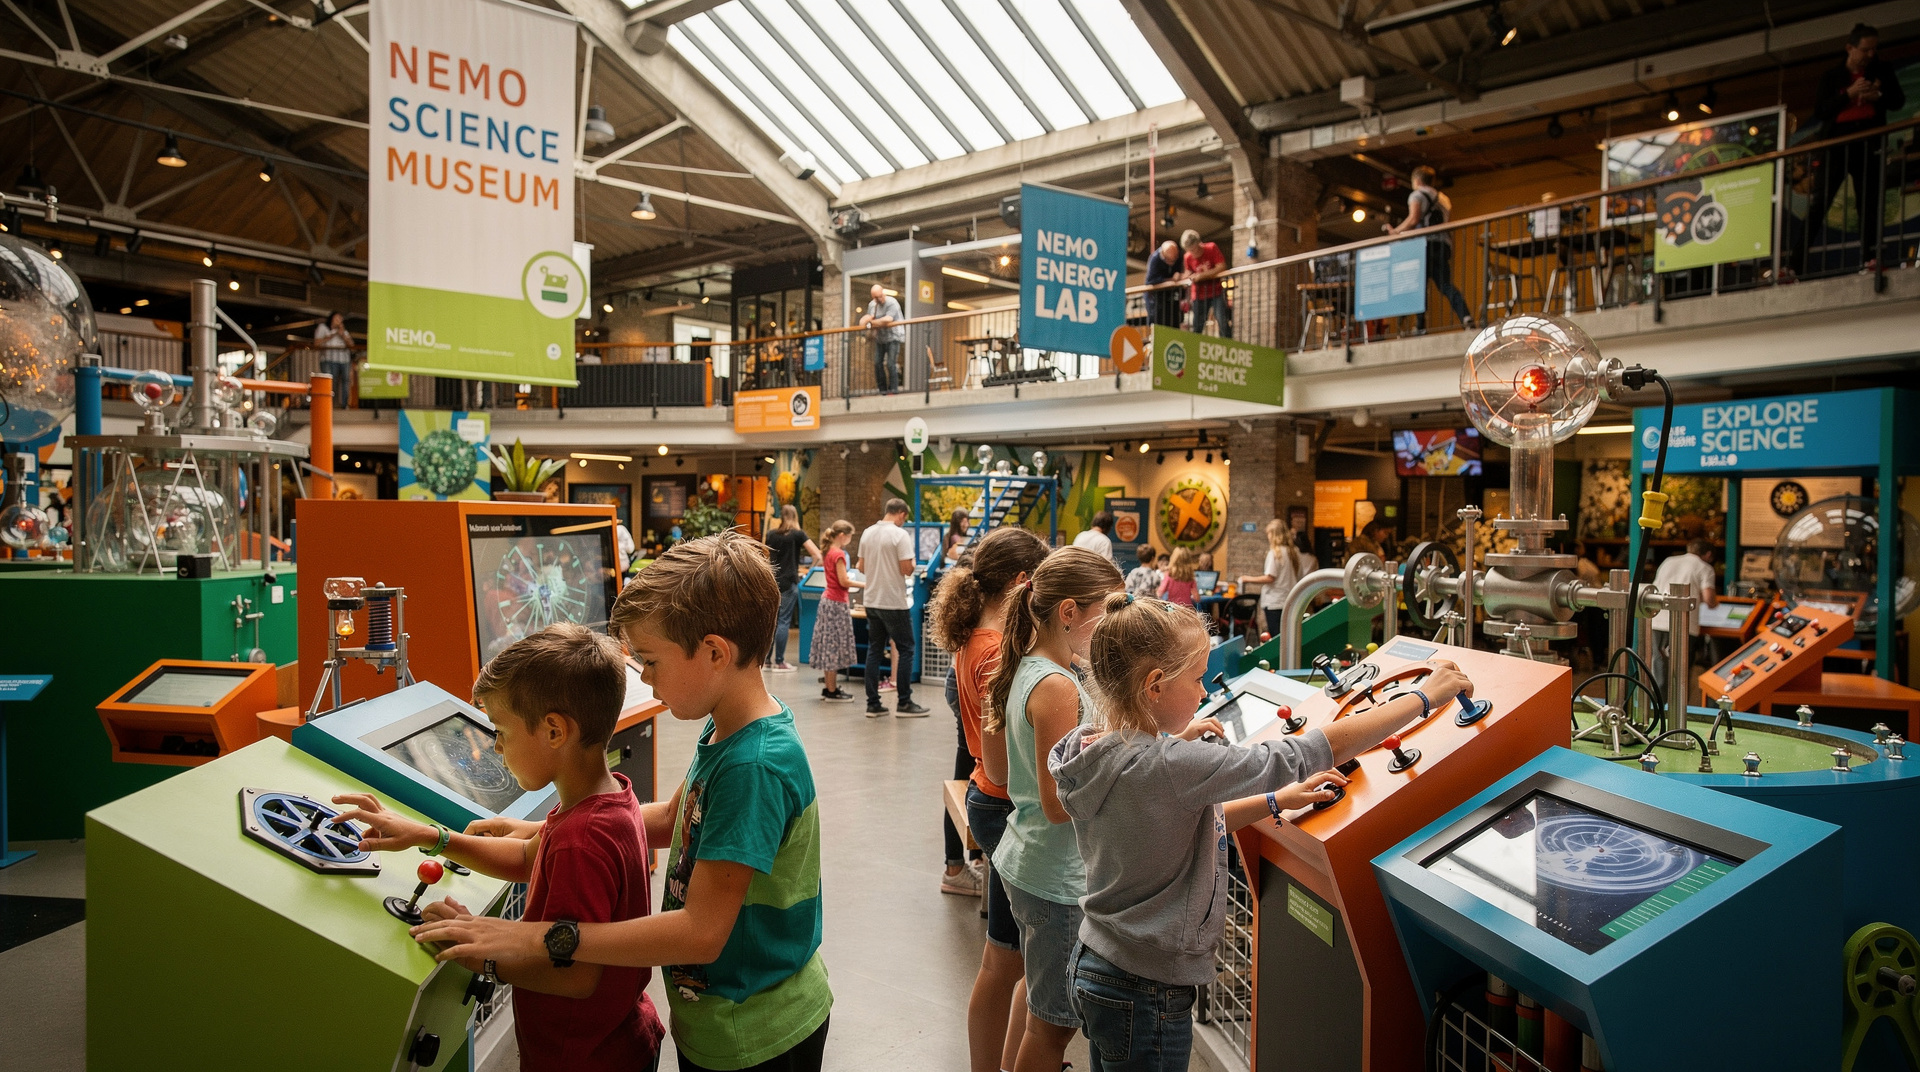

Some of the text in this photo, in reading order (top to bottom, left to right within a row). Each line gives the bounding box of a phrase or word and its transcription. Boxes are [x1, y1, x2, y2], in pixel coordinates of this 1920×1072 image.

[390, 42, 527, 107] NEMO
[388, 97, 559, 163] SCIENCE
[387, 147, 559, 210] MUSEUM
[1037, 229, 1098, 260] NEMO
[1036, 257, 1118, 291] ENERGY
[1035, 284, 1098, 324] LAB
[386, 327, 436, 347] NEMO
[1199, 341, 1253, 367] EXPLORE
[1198, 362, 1247, 386] SCIENCE
[1702, 400, 1819, 429] EXPLORE
[1701, 426, 1805, 453] SCIENCE
